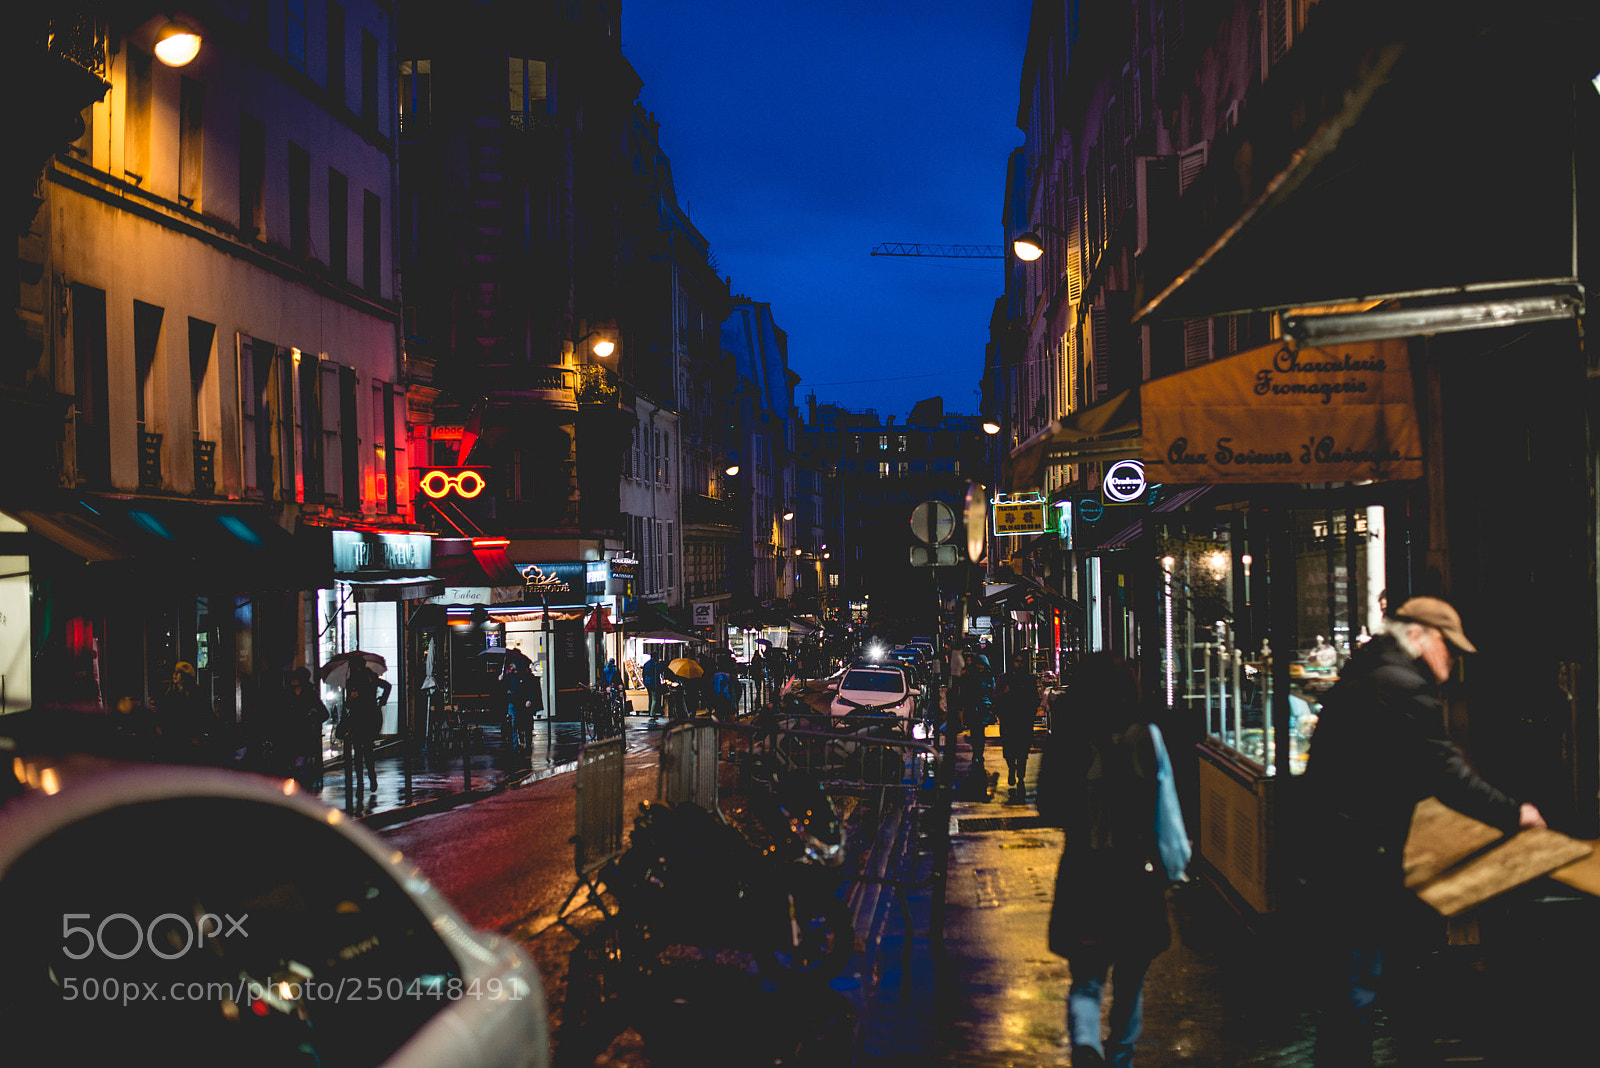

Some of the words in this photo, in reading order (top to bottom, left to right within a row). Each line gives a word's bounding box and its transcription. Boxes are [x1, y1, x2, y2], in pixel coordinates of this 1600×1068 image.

[1273, 345, 1387, 373] Charcuterie
[1254, 369, 1367, 404] Fromagerie
[1167, 437, 1209, 465] Aux
[451, 588, 481, 600] Tabac
